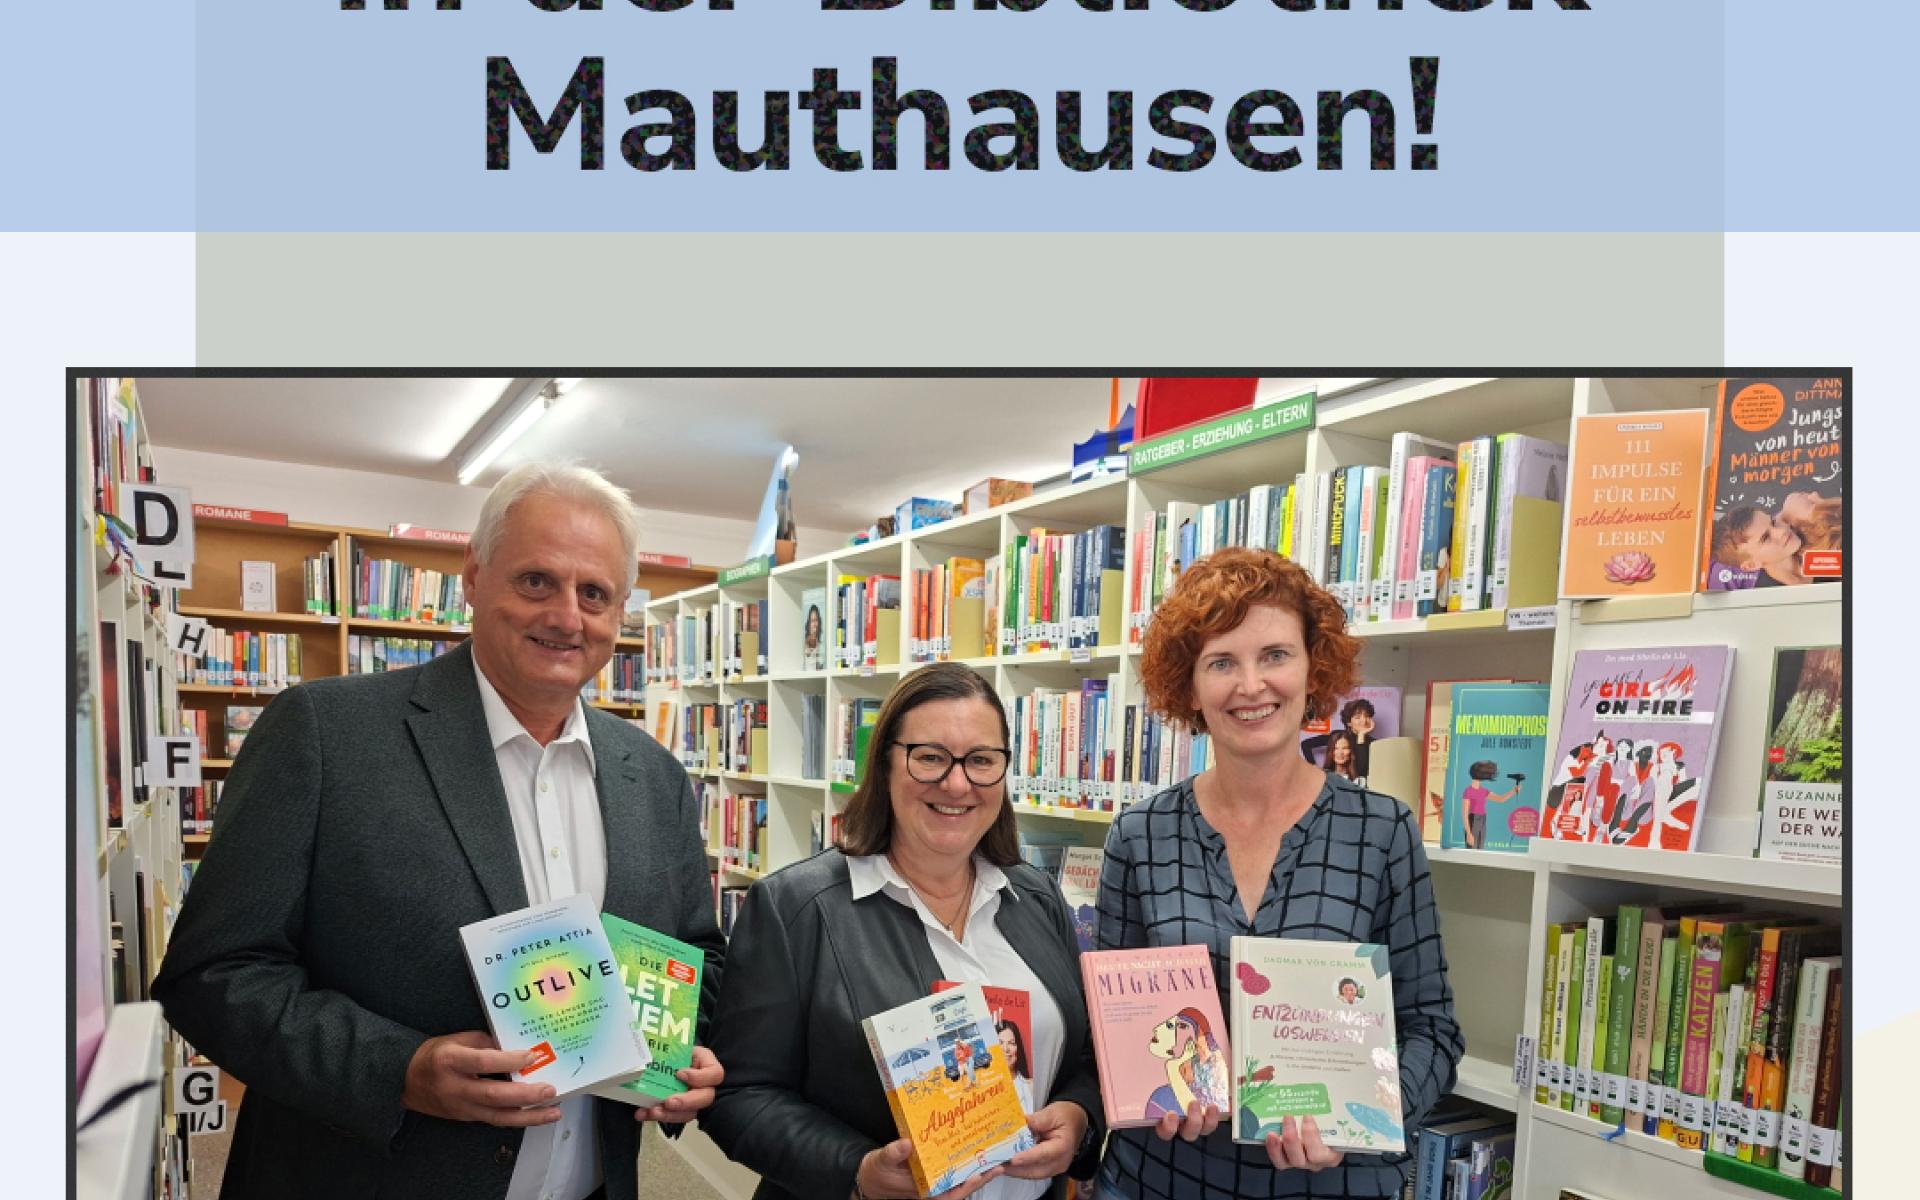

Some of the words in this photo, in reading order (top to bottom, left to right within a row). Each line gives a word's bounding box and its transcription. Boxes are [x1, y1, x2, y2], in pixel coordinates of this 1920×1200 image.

[1789, 406, 1842, 428] Jungs
[1134, 439, 1184, 467] RATGEBER
[1192, 418, 1253, 450] ERZIEHUNG
[1261, 403, 1308, 429] ELTERN
[1755, 435, 1787, 452] von
[1626, 440, 1650, 454] 111
[1730, 448, 1802, 471] Männer
[1807, 442, 1839, 459] von
[1591, 461, 1683, 480] IMPULSE
[1743, 462, 1814, 485] morgen
[1593, 486, 1635, 504] FÜR
[1640, 486, 1676, 502] EIN
[134, 491, 178, 545] D
[195, 506, 252, 521] ROMANE
[1330, 476, 1346, 546] MINDFUCK
[1575, 502, 1694, 527] selbstbewusstes
[1597, 530, 1665, 546] LEBEN
[178, 623, 205, 653] H
[1600, 681, 1653, 698] GIRL
[1596, 700, 1629, 715] ON
[1637, 700, 1693, 715] FIRE
[1456, 714, 1548, 736] MENOMORPHOS
[166, 741, 191, 779] F
[1779, 806, 1807, 819] DIE
[1780, 822, 1814, 836] DER
[1821, 825, 1842, 838] W
[484, 953, 508, 966] DR.
[512, 939, 552, 956] PETER
[559, 928, 593, 943] ATTIA
[1762, 954, 1771, 962] Z
[640, 956, 663, 972] DIE
[1263, 956, 1303, 965] DAGMAR
[1307, 959, 1327, 967] VON
[1329, 960, 1366, 968] CRAMM
[492, 959, 614, 1009] OUTLIVE
[620, 964, 679, 1007] LET
[1098, 967, 1213, 997] MIGRÄNE
[1641, 969, 1652, 986] DIE
[1760, 979, 1768, 988] A
[1640, 989, 1649, 1000] IN
[1690, 966, 1713, 1038] KATZEN
[1637, 1002, 1649, 1040] HÄNDE
[182, 1071, 215, 1106] G
[188, 1104, 224, 1133] I/J
[918, 1081, 1006, 1143] Abgefahren
[1677, 1133, 1699, 1145] GU
